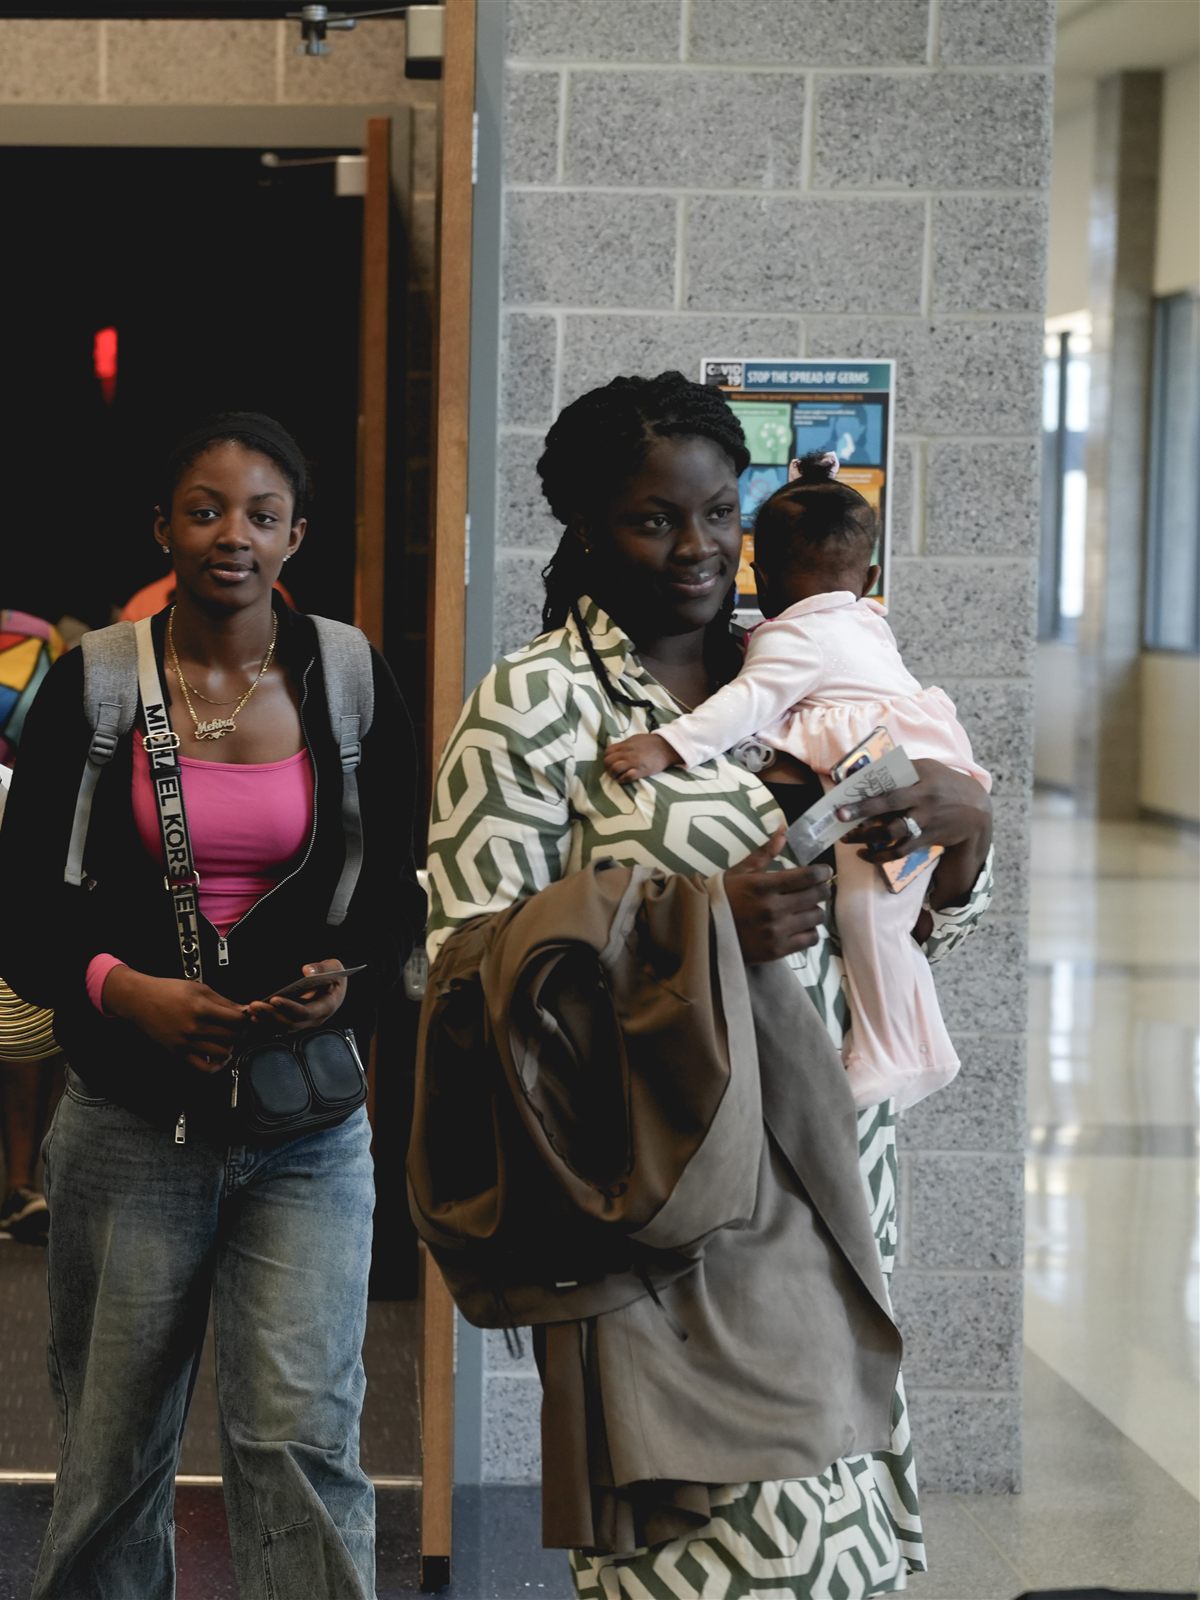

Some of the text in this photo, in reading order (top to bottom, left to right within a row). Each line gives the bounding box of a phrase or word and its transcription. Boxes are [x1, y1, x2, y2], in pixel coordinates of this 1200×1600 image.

[707, 364, 741, 376] COVID
[727, 375, 742, 386] 19
[747, 371, 869, 384] STOP THE SPREAD OF GERMS
[163, 814, 189, 880] KORS
